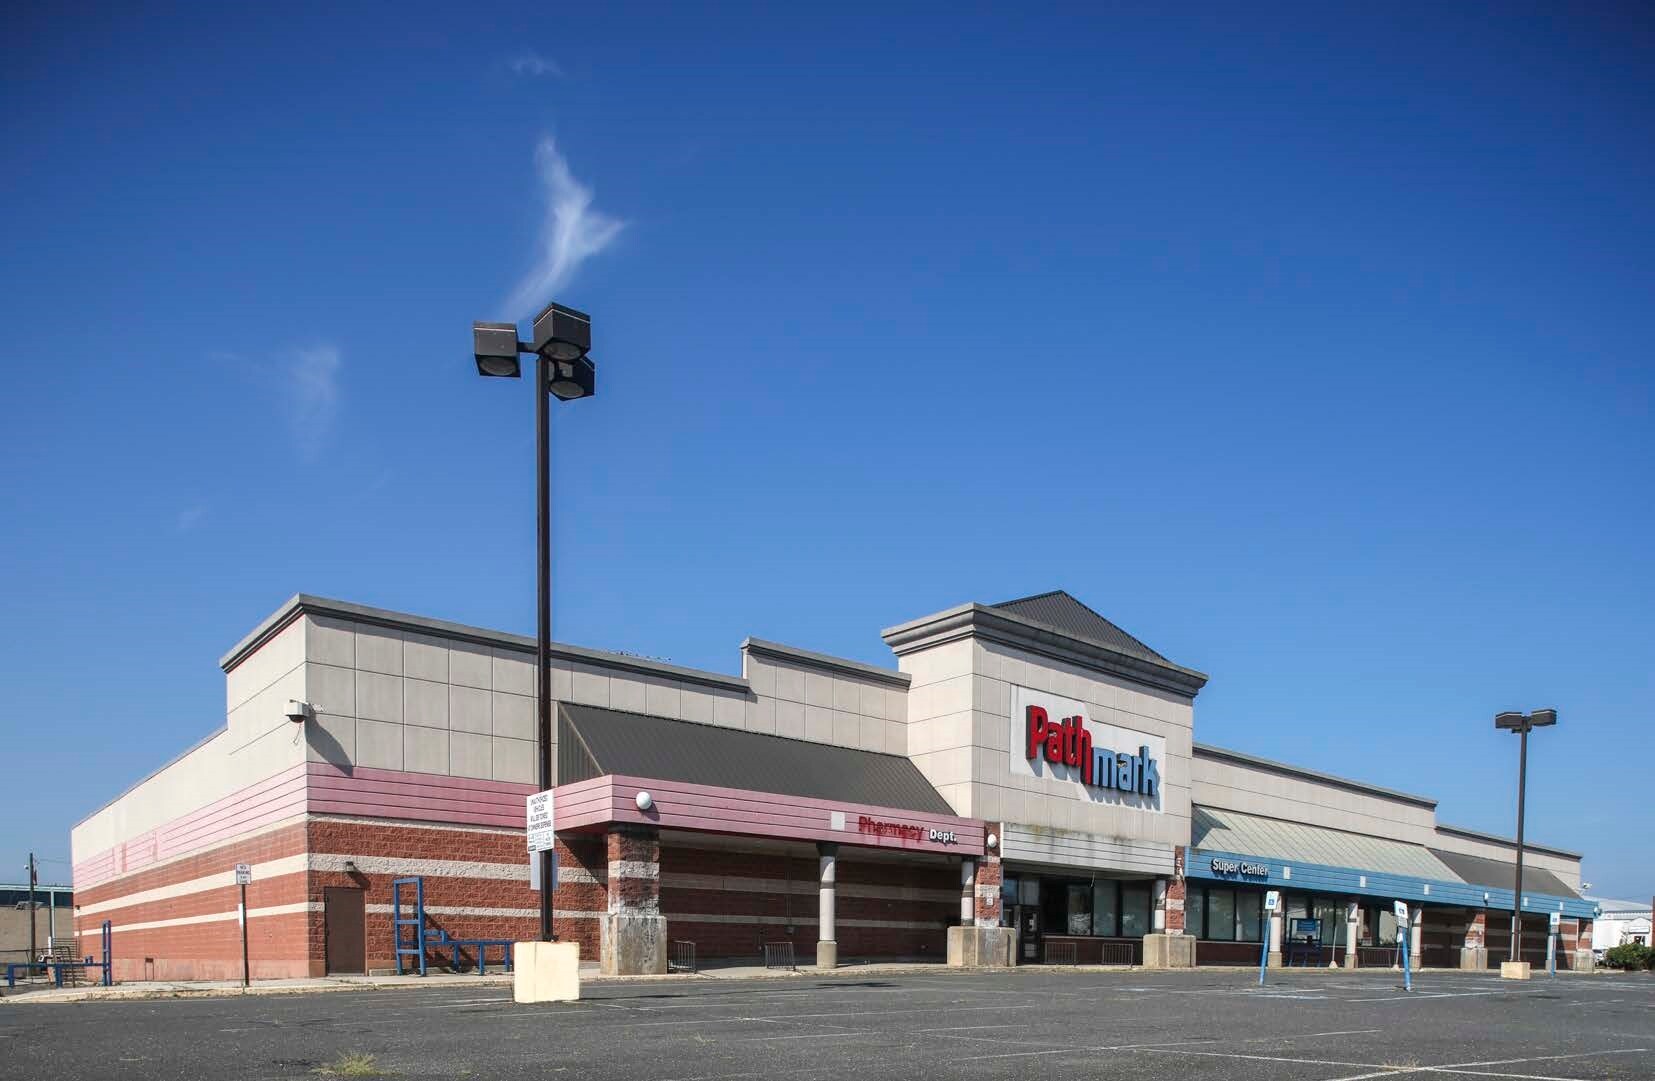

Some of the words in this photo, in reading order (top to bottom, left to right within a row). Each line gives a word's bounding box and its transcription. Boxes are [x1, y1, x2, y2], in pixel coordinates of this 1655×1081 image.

[1026, 705, 1160, 797] Pathmark
[929, 828, 958, 844] Dept.
[1211, 858, 1239, 875] Super
[1240, 862, 1269, 877] Center
